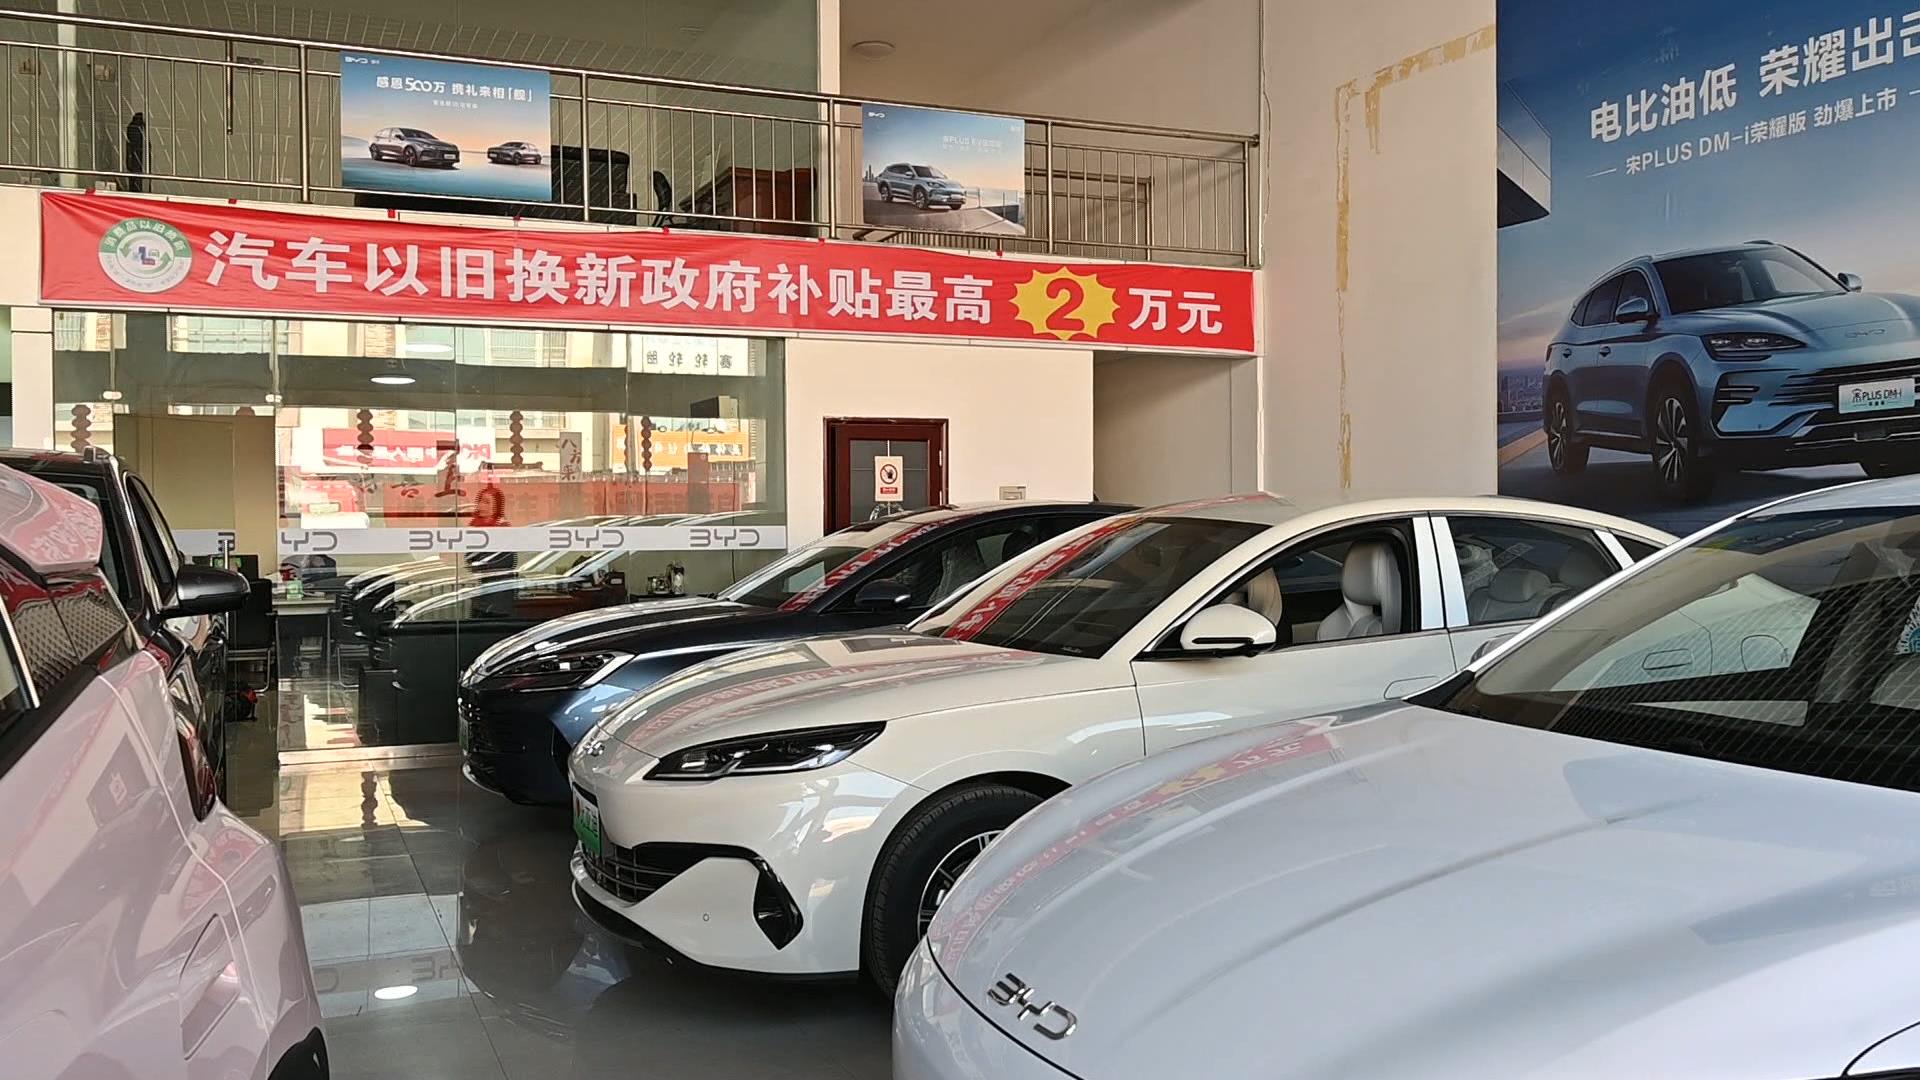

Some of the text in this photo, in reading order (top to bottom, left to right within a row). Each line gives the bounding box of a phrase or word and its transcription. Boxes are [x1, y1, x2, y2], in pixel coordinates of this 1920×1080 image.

[1590, 62, 1738, 144] 电比油低
[1625, 87, 1898, 176] 宋PLUS DM-i荣耀版 劲爆上市
[203, 230, 992, 324] 汽车以旧换新政府补贴最高
[1044, 279, 1085, 332] 2
[1128, 287, 1223, 334] 万元
[409, 531, 489, 551] BYD
[549, 530, 625, 549] BYD
[689, 529, 760, 548] BYD
[987, 972, 1078, 1040] BYD
